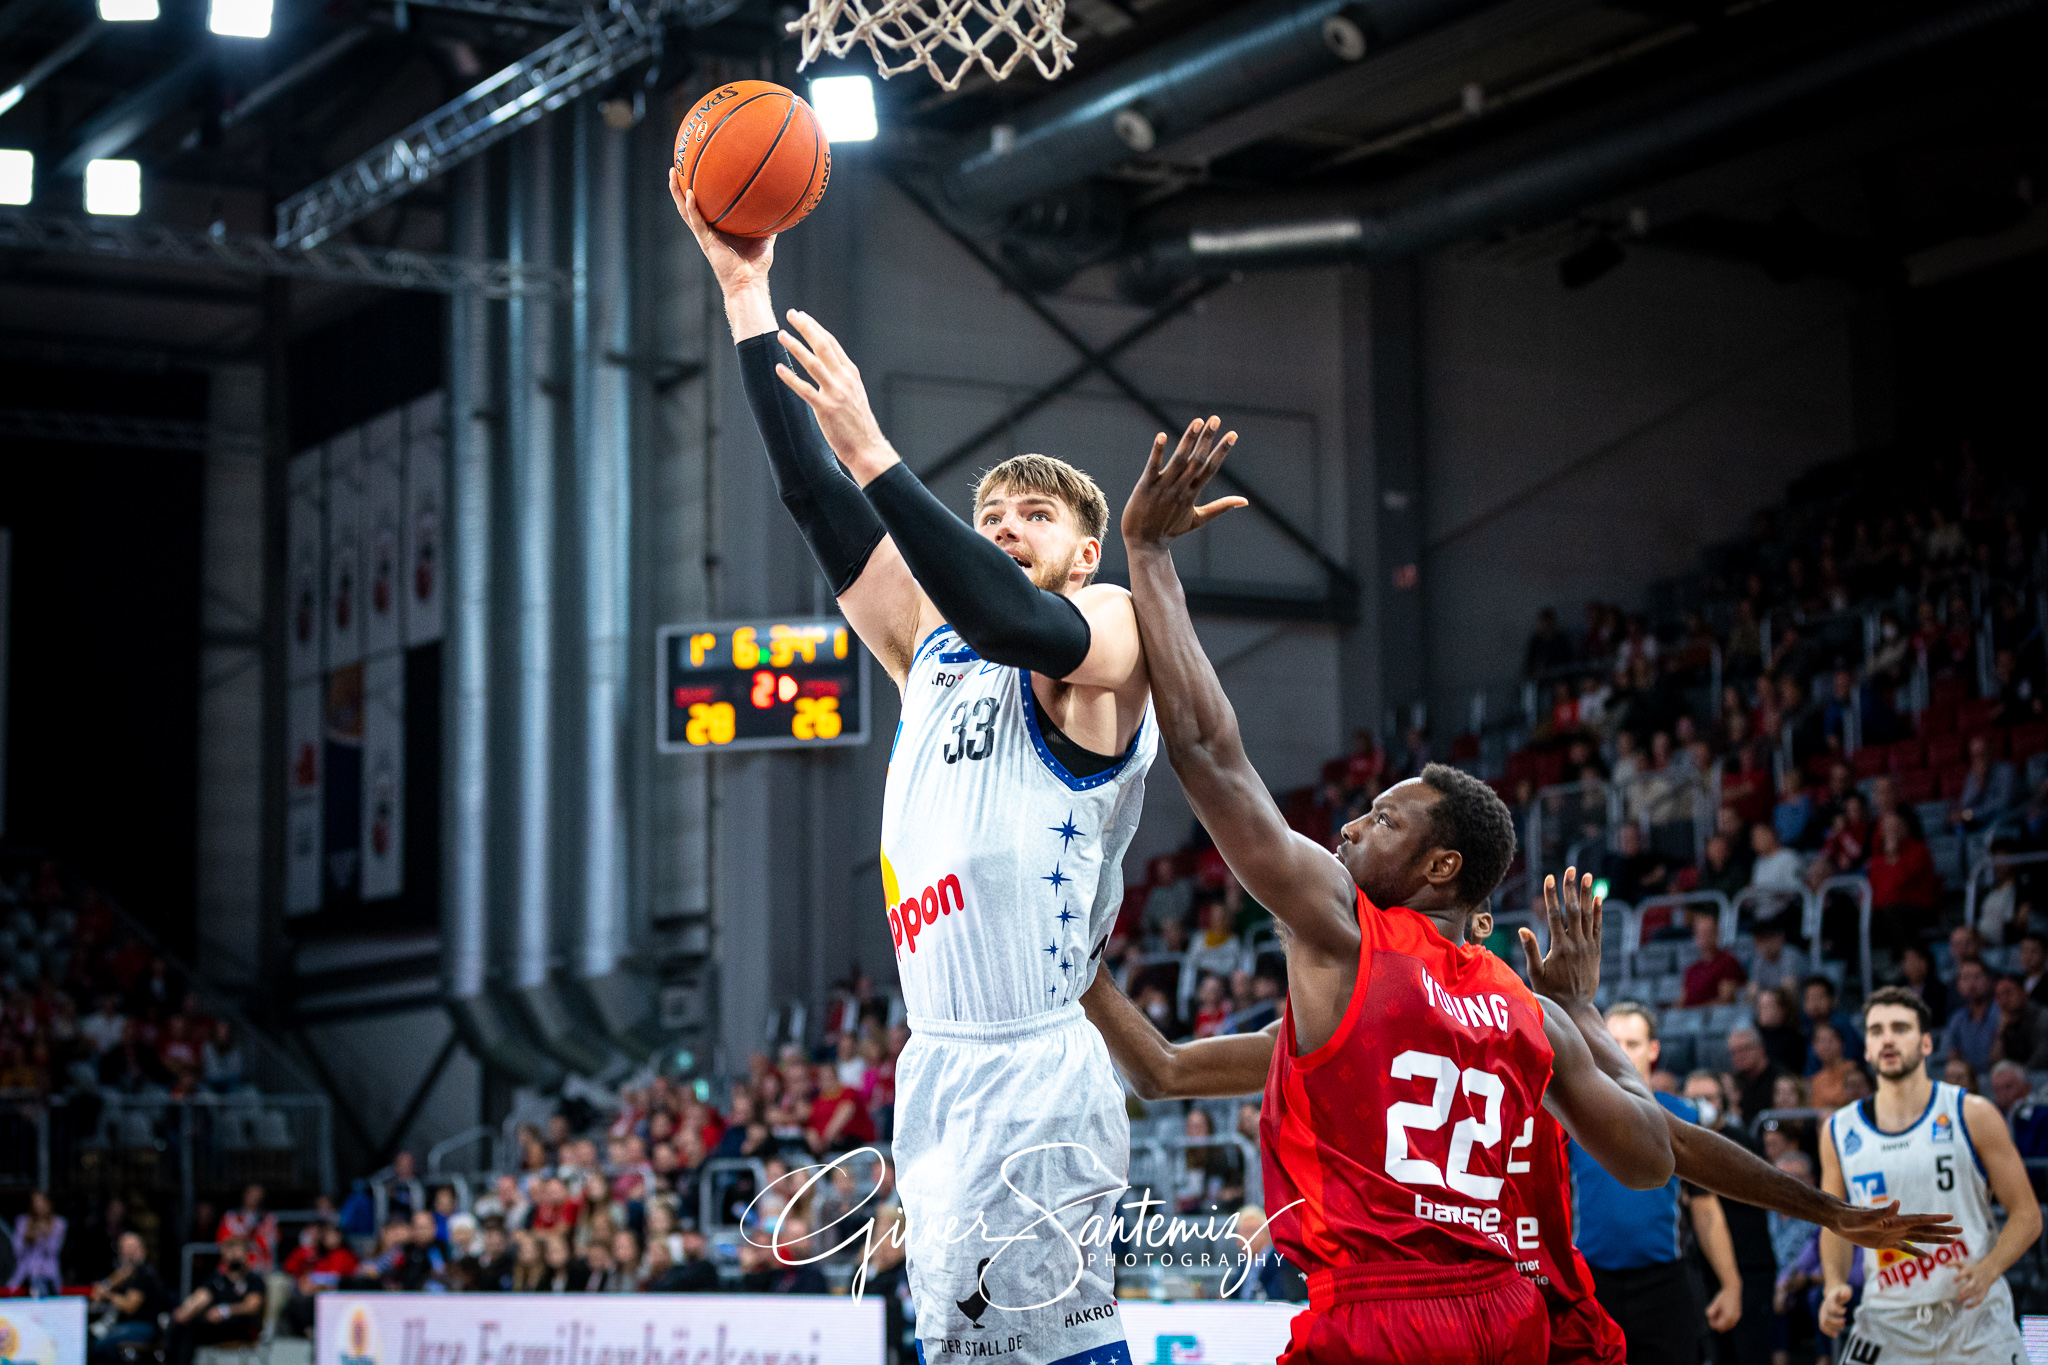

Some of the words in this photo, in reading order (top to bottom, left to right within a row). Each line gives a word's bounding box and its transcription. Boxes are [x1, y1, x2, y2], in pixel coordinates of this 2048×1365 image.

[675, 86, 739, 178] SPALDING
[792, 696, 842, 740] 26
[943, 696, 1000, 765] 33
[888, 874, 965, 962] ppon
[1422, 967, 1508, 1033] YOUNG
[1384, 1049, 1505, 1201] 22
[1936, 1155, 1955, 1192] 5
[1878, 1240, 1969, 1291] nippon
[1064, 1303, 1115, 1328] HAKRO
[940, 1338, 963, 1355] DER
